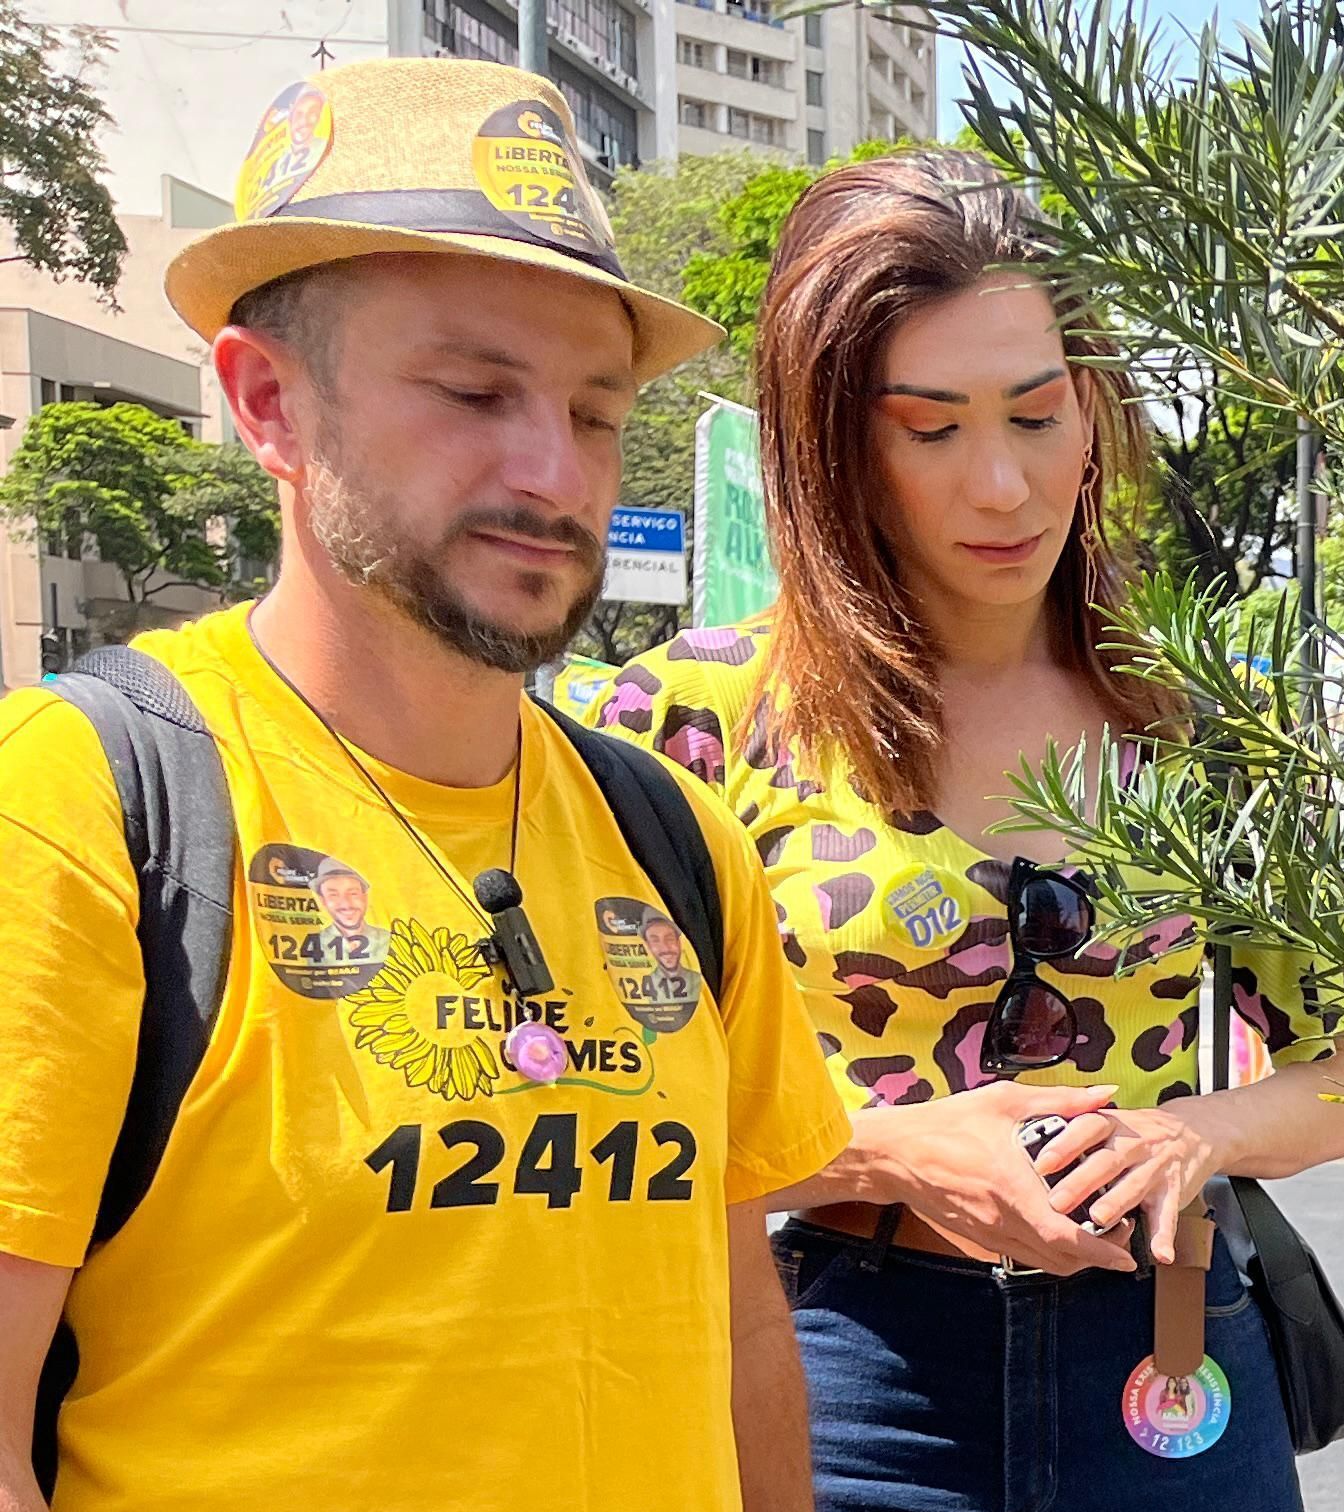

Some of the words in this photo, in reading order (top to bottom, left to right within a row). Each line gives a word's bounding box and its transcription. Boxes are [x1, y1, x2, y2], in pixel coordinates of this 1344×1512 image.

[906, 896, 962, 947] D12
[268, 932, 370, 962] 12412
[618, 975, 688, 1001] 12412
[363, 1112, 697, 1213] 12412
